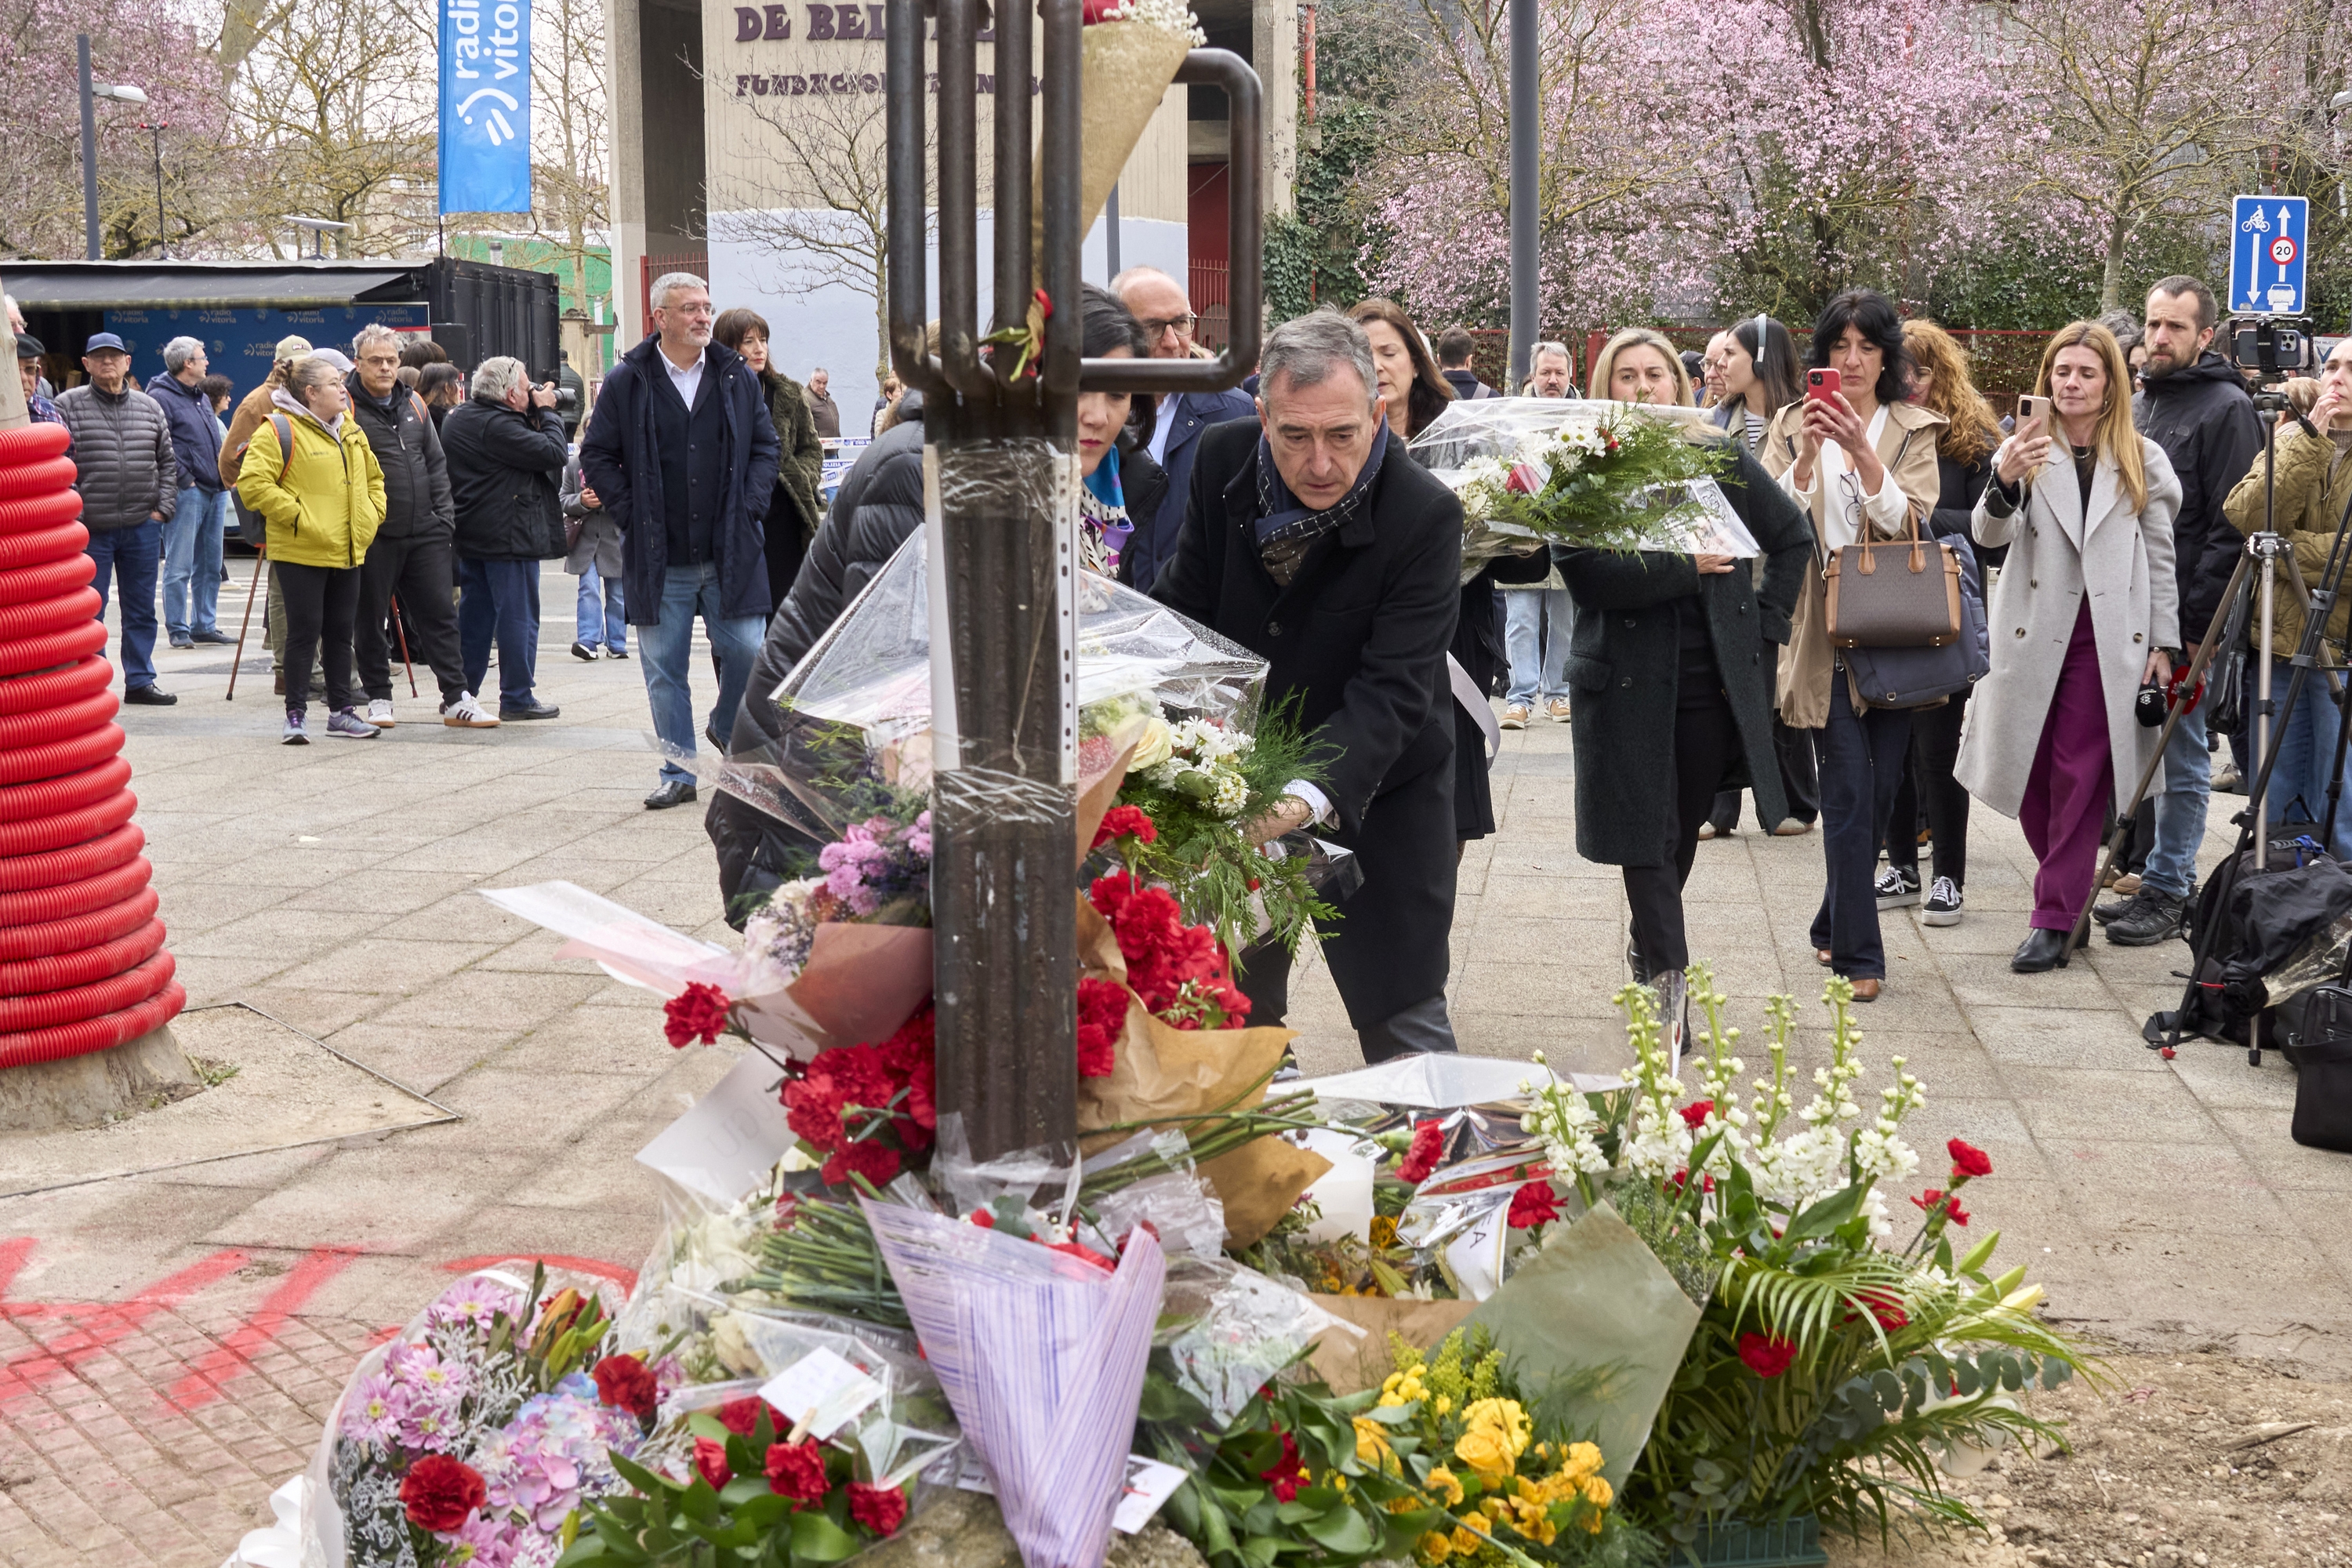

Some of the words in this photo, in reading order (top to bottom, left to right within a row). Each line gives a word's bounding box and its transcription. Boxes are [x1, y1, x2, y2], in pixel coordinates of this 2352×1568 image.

[734, 4, 790, 42] DE
[448, 0, 480, 78] radi
[483, 0, 519, 80] vito
[735, 72, 887, 96] FUNDACIO
[2276, 246, 2291, 256] 20
[299, 315, 325, 324] vitoria
[387, 314, 413, 323] vitoria
